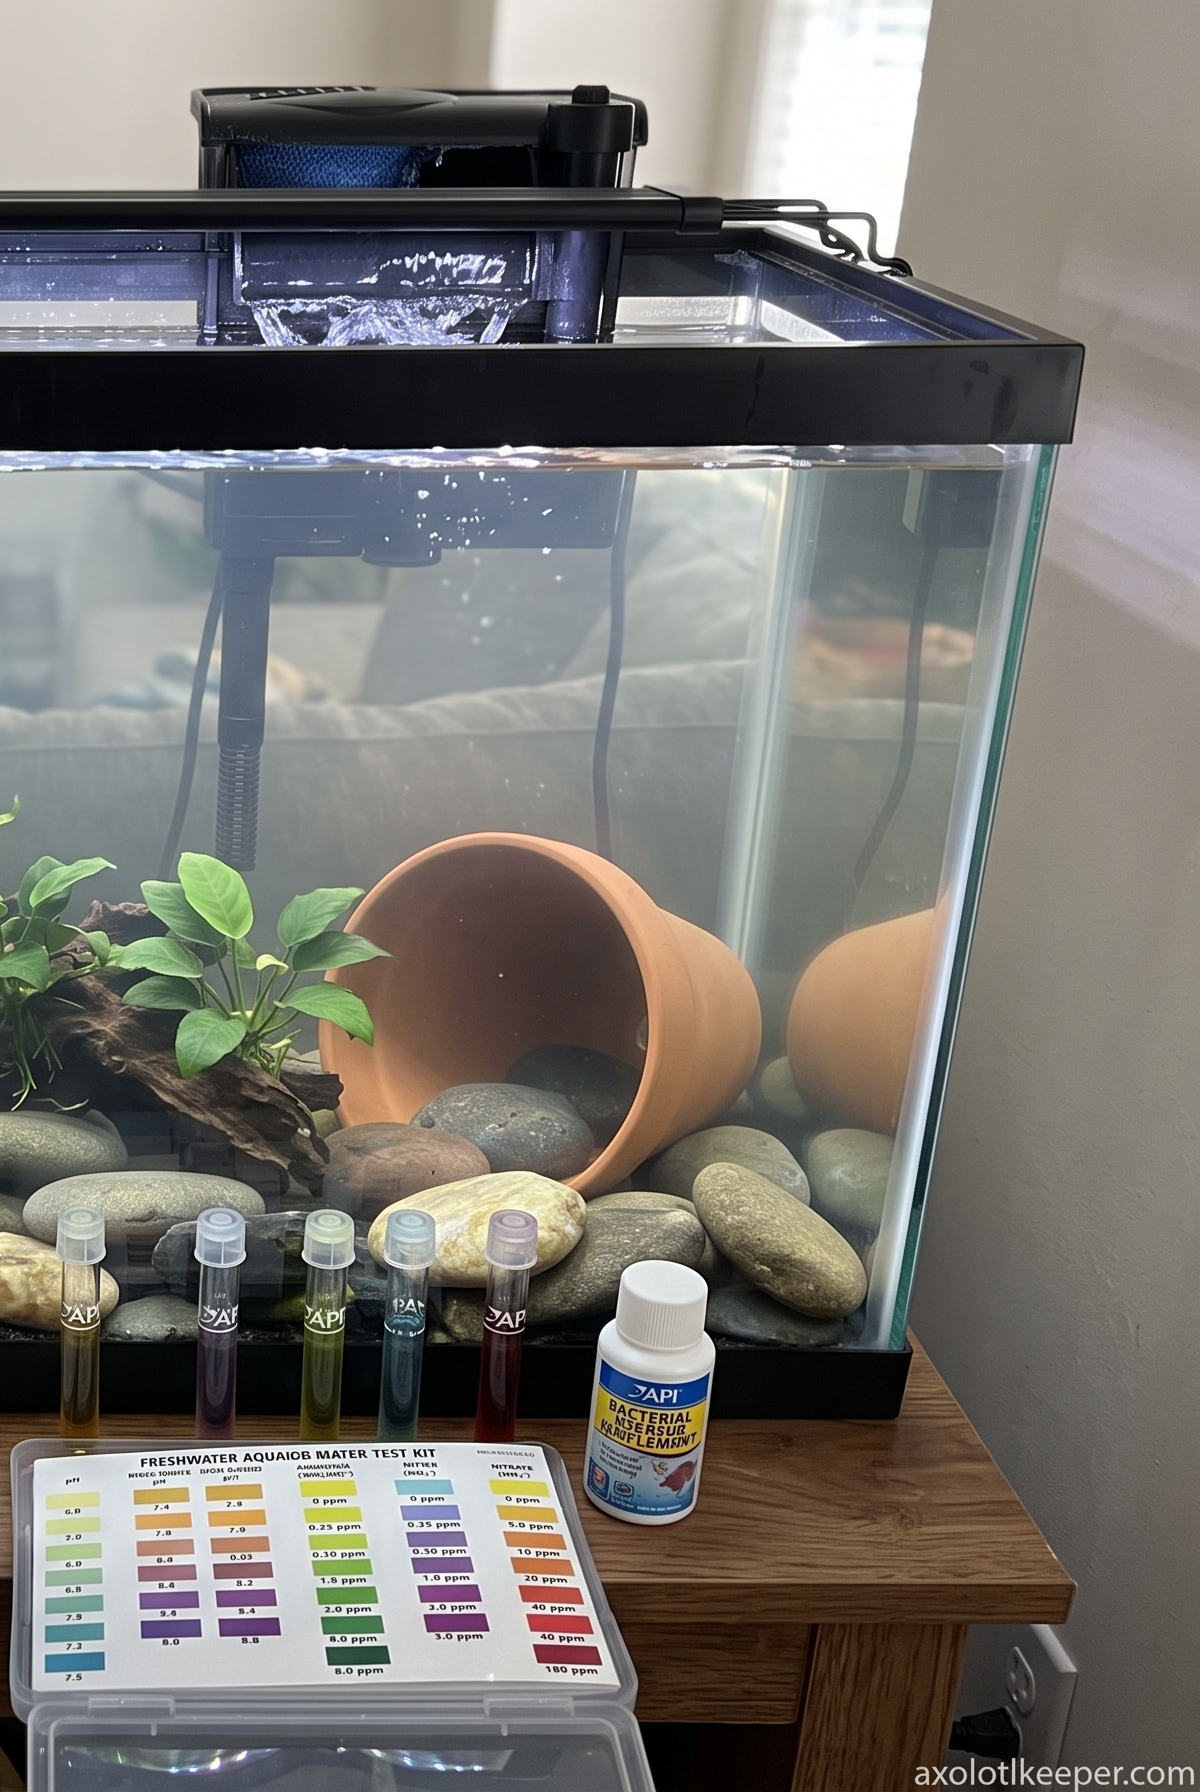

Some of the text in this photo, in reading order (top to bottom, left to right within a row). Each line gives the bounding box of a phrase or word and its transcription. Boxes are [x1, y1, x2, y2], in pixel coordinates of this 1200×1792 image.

[642, 1388, 678, 1404] API
[609, 1398, 692, 1425] BACTERIAL
[140, 1453, 238, 1468] FRESHWATER
[374, 1448, 406, 1459] TEST
[413, 1448, 436, 1458] KIT
[337, 1524, 361, 1532] ppm
[436, 1521, 461, 1529] ppm
[529, 1523, 554, 1531] ppm
[341, 1551, 366, 1559] ppm
[441, 1548, 467, 1556] ppm
[517, 1548, 560, 1558] 10 ppm
[342, 1577, 367, 1585] ppm
[445, 1575, 470, 1583] ppm
[542, 1576, 568, 1584] ppm
[346, 1606, 372, 1614] ppm
[450, 1604, 477, 1612] ppm
[550, 1605, 576, 1613] ppm
[351, 1635, 378, 1644] ppm
[457, 1633, 484, 1642] ppm
[540, 1633, 585, 1643] 40 ppm
[357, 1667, 384, 1676] ppm
[545, 1665, 599, 1676] 180 ppm
[65, 1673, 82, 1681] 7.5
